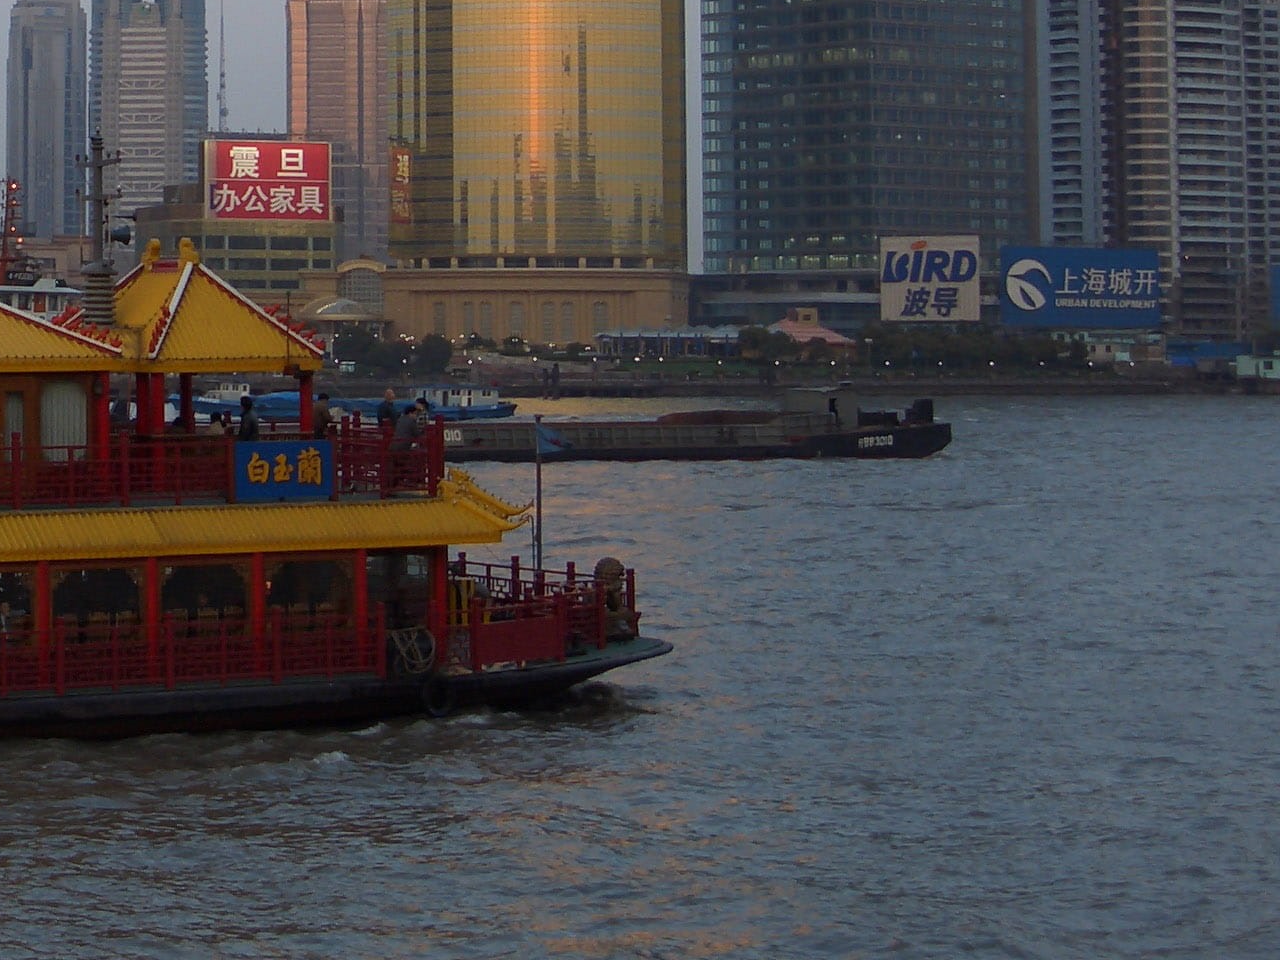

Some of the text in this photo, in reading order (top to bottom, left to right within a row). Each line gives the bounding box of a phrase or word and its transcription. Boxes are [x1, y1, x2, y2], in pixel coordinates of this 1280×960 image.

[229, 146, 309, 178] 震旦
[213, 183, 325, 215] 办公家具
[1055, 268, 1157, 295] 上海城开
[900, 287, 959, 317] 波导
[1055, 298, 1157, 309] URBAN DEVELOPMENT
